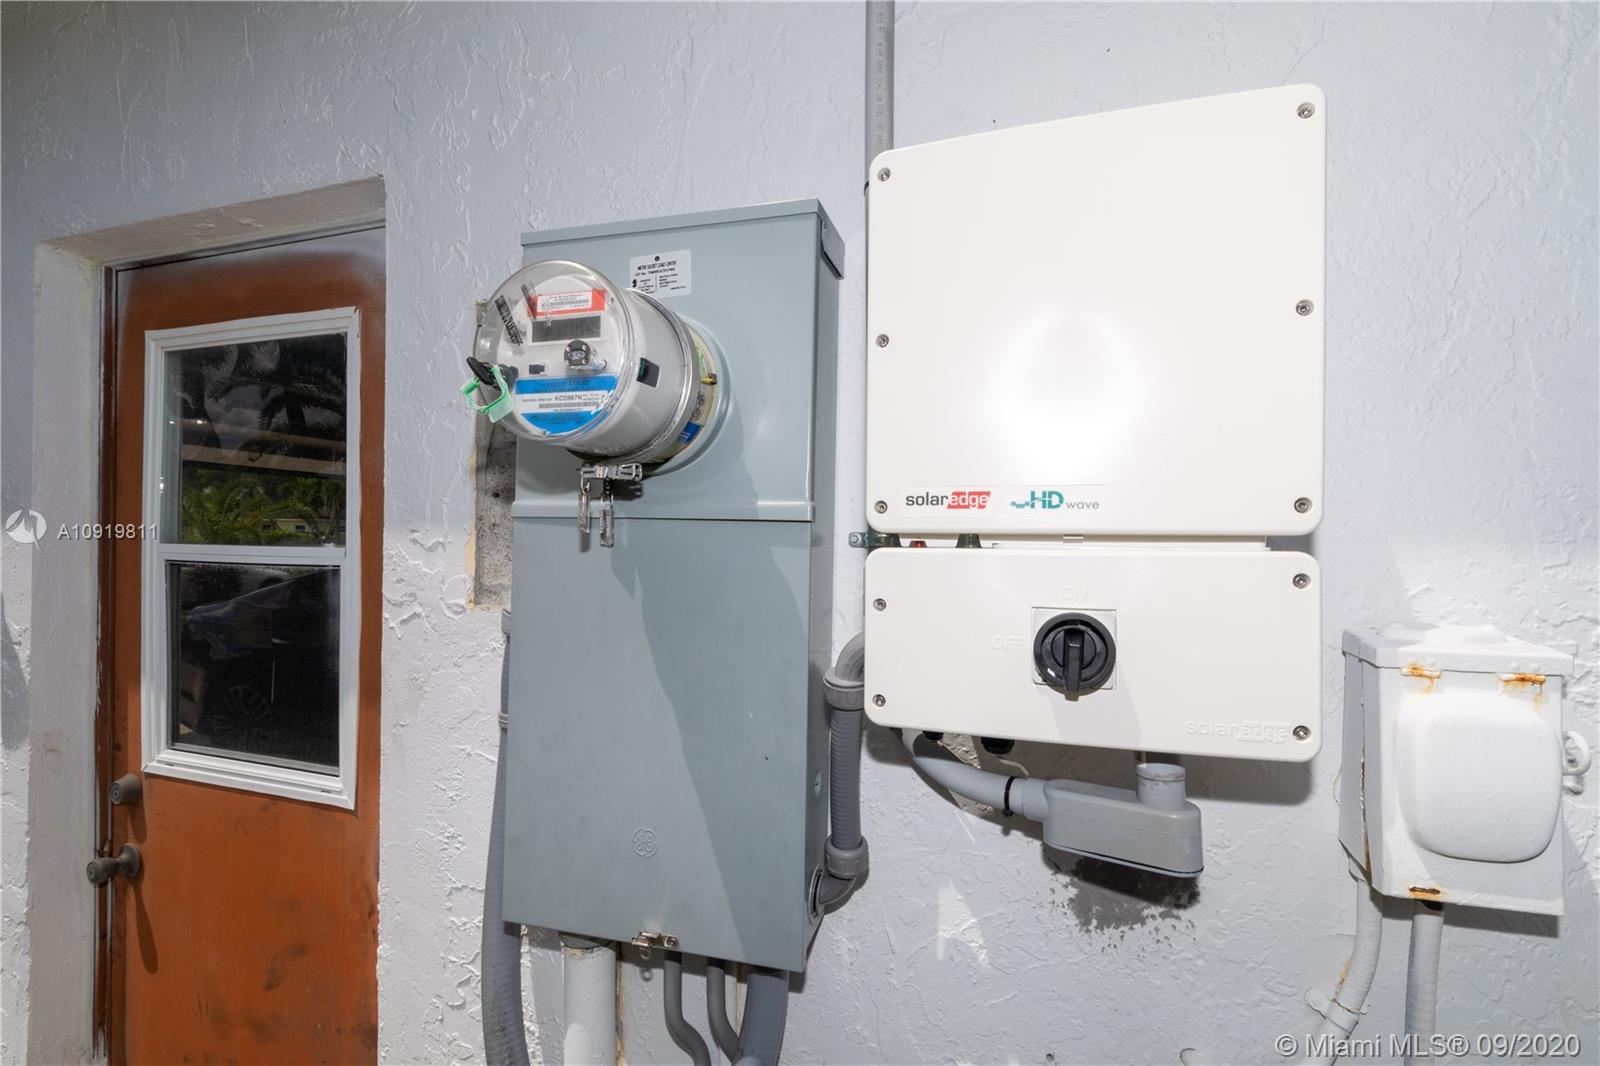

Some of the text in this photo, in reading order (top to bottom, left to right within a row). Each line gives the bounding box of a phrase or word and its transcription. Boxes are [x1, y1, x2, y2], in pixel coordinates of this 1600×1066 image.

[905, 490, 1100, 510] solaredge HD wave
[1063, 586, 1088, 602] ON
[991, 634, 1026, 653] OFF
[1184, 719, 1289, 744] solaredge
